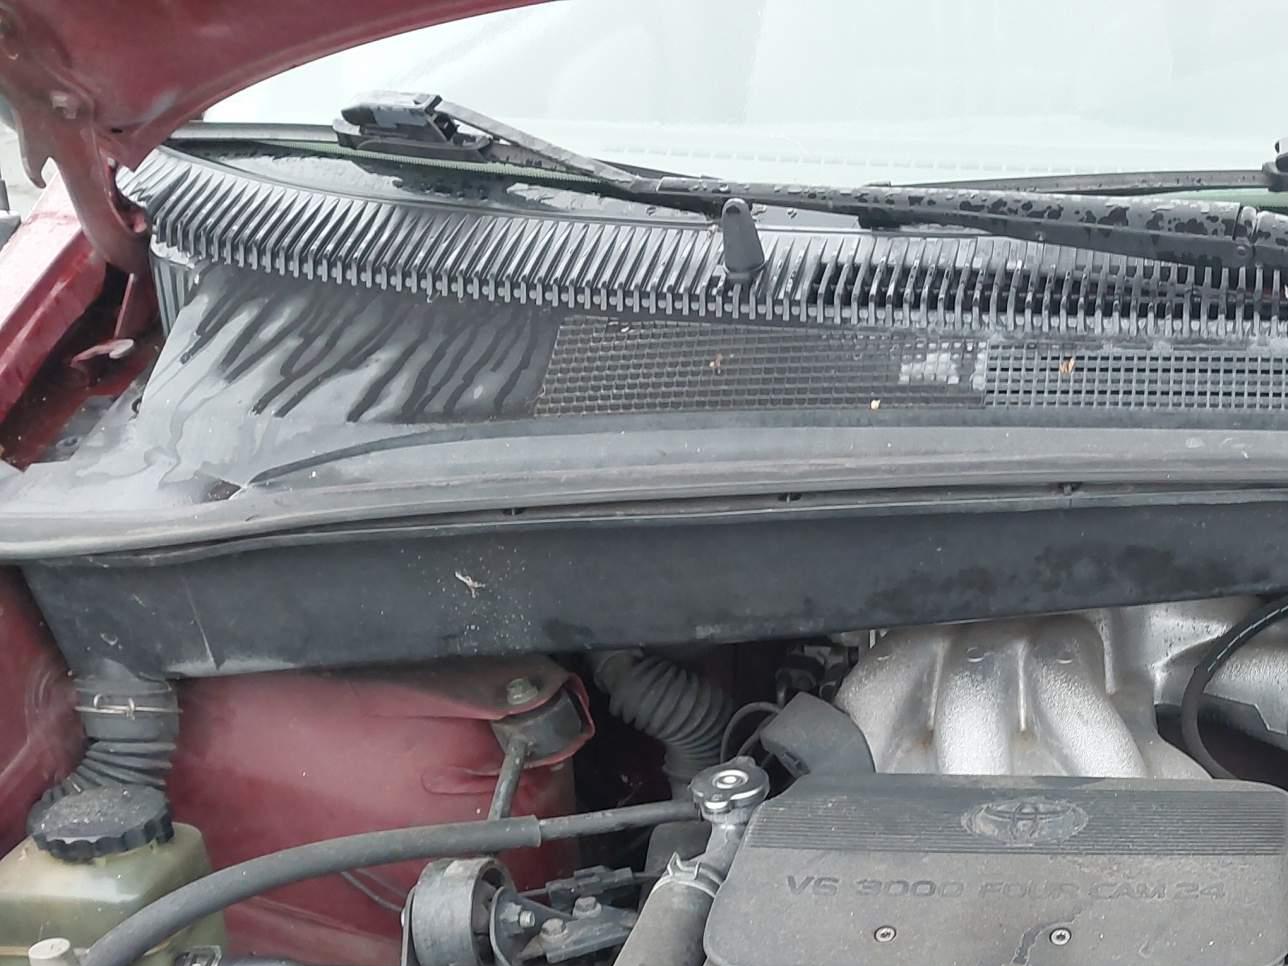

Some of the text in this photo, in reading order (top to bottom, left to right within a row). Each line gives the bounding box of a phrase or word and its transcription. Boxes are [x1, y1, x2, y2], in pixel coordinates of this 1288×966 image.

[856, 879, 965, 898] 3000
[978, 881, 1080, 900] FOUR
[1088, 881, 1167, 900] CAM
[1174, 881, 1226, 899] 24
